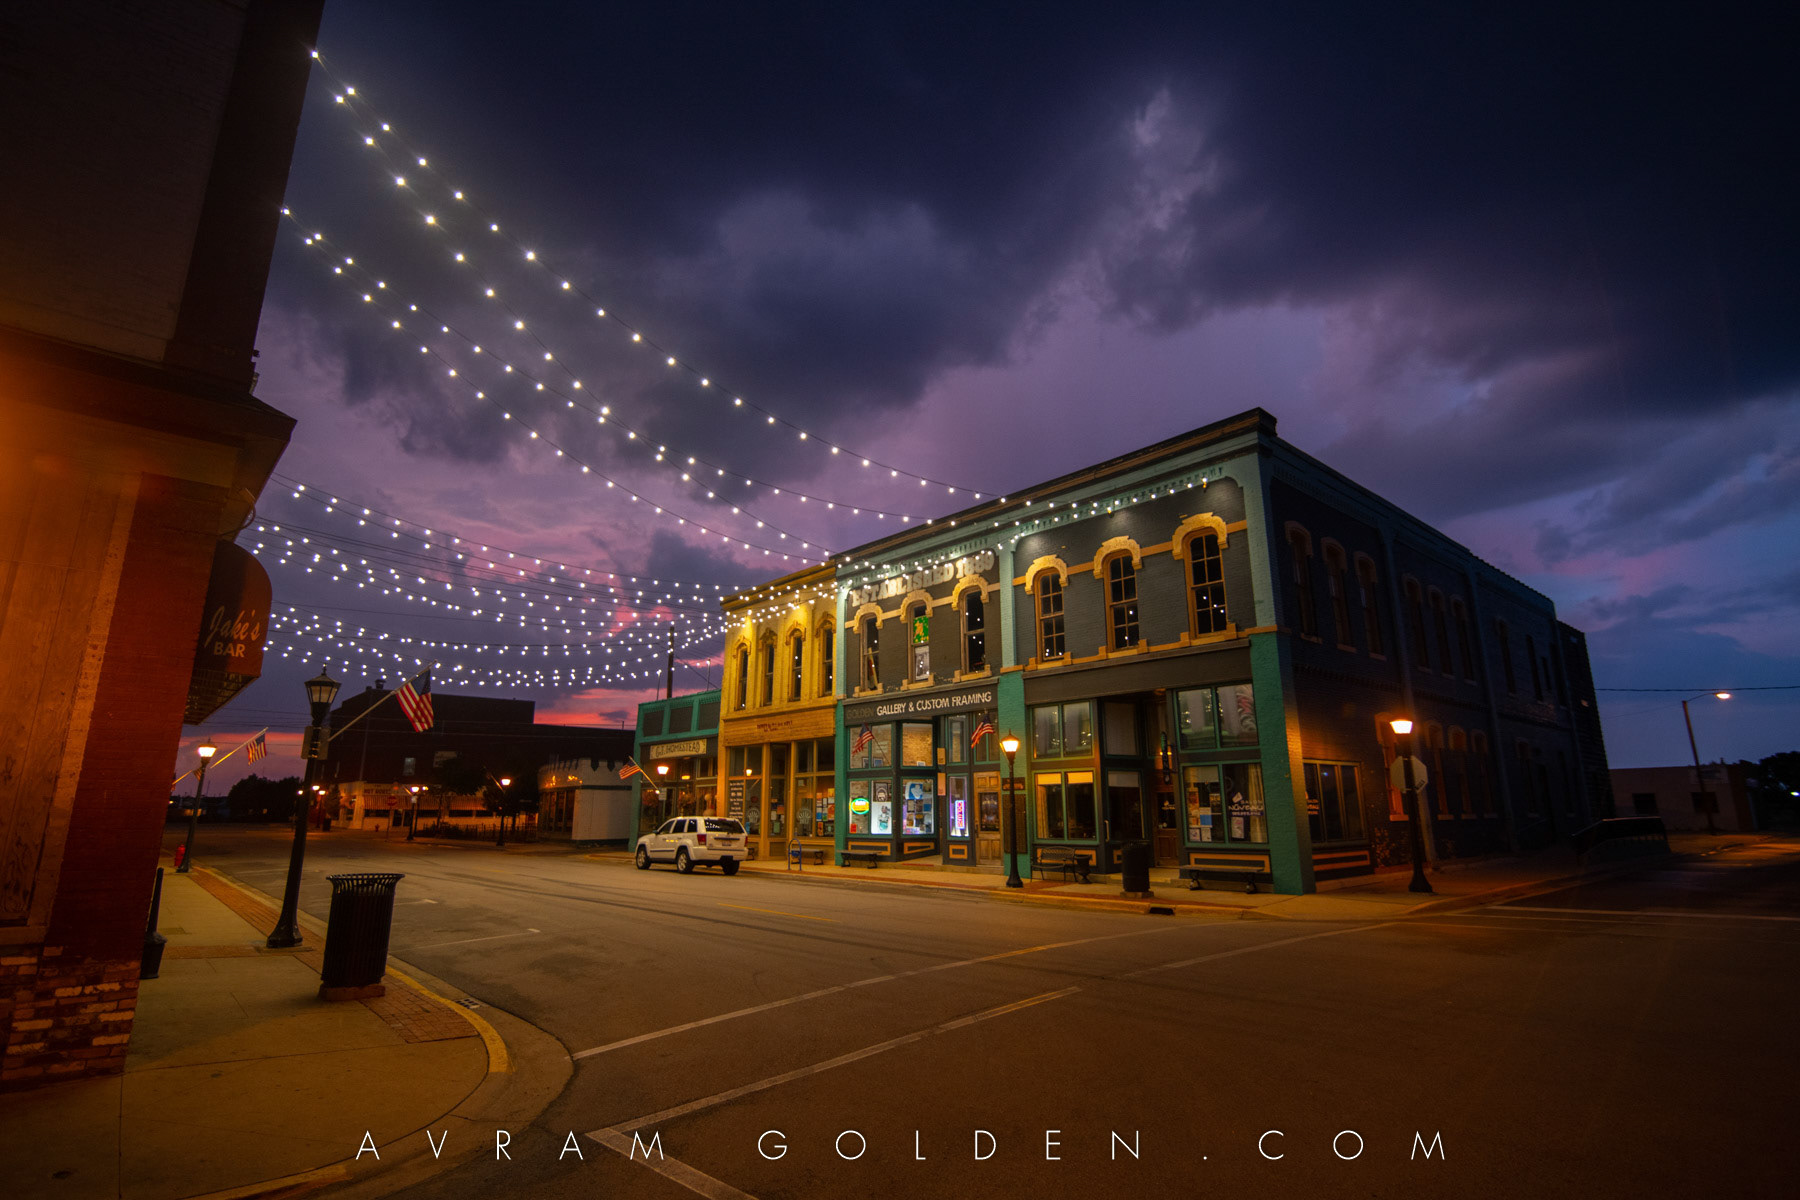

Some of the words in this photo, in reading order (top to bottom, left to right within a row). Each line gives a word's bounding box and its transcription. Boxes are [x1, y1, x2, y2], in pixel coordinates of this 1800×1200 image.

[852, 563, 954, 607] ESTABLISHED
[204, 605, 260, 648] Jake's
[214, 641, 246, 657] BAR
[876, 702, 907, 716] GALLERY
[908, 701, 915, 712] &
[916, 697, 950, 711] CUSTOM
[951, 691, 992, 707] FRAMING
